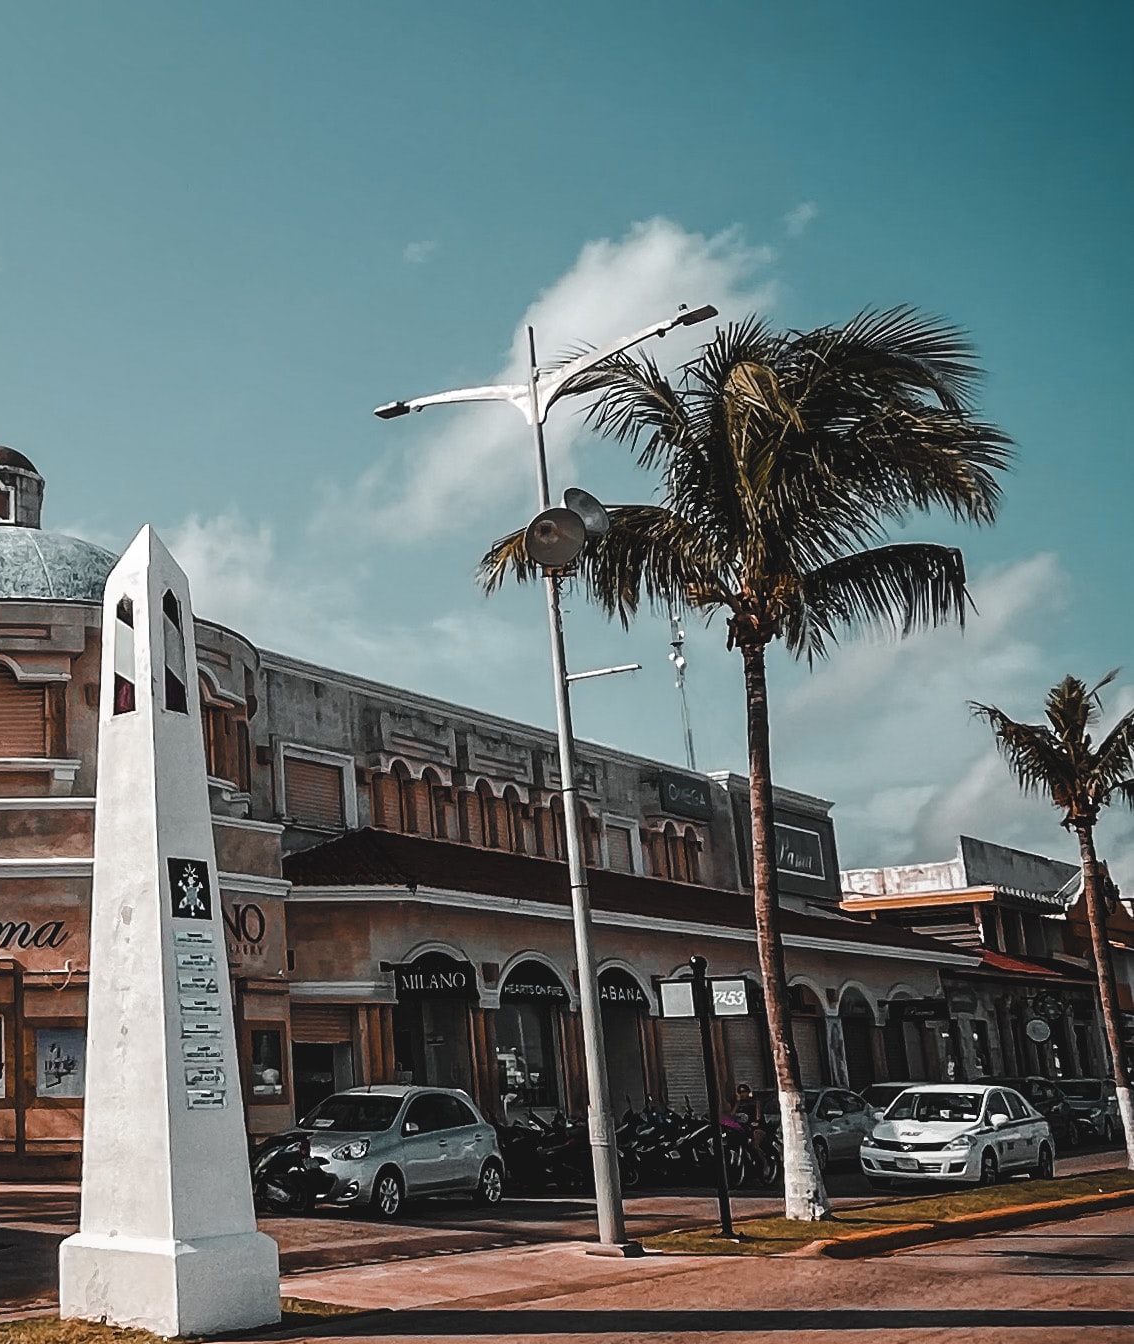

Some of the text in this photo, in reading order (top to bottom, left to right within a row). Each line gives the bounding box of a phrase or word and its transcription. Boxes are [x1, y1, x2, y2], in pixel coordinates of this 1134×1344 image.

[401, 972, 466, 990] MILANO
[504, 983, 535, 995] HEARTS
[535, 984, 546, 995] ON
[601, 985, 644, 1002] ABANA
